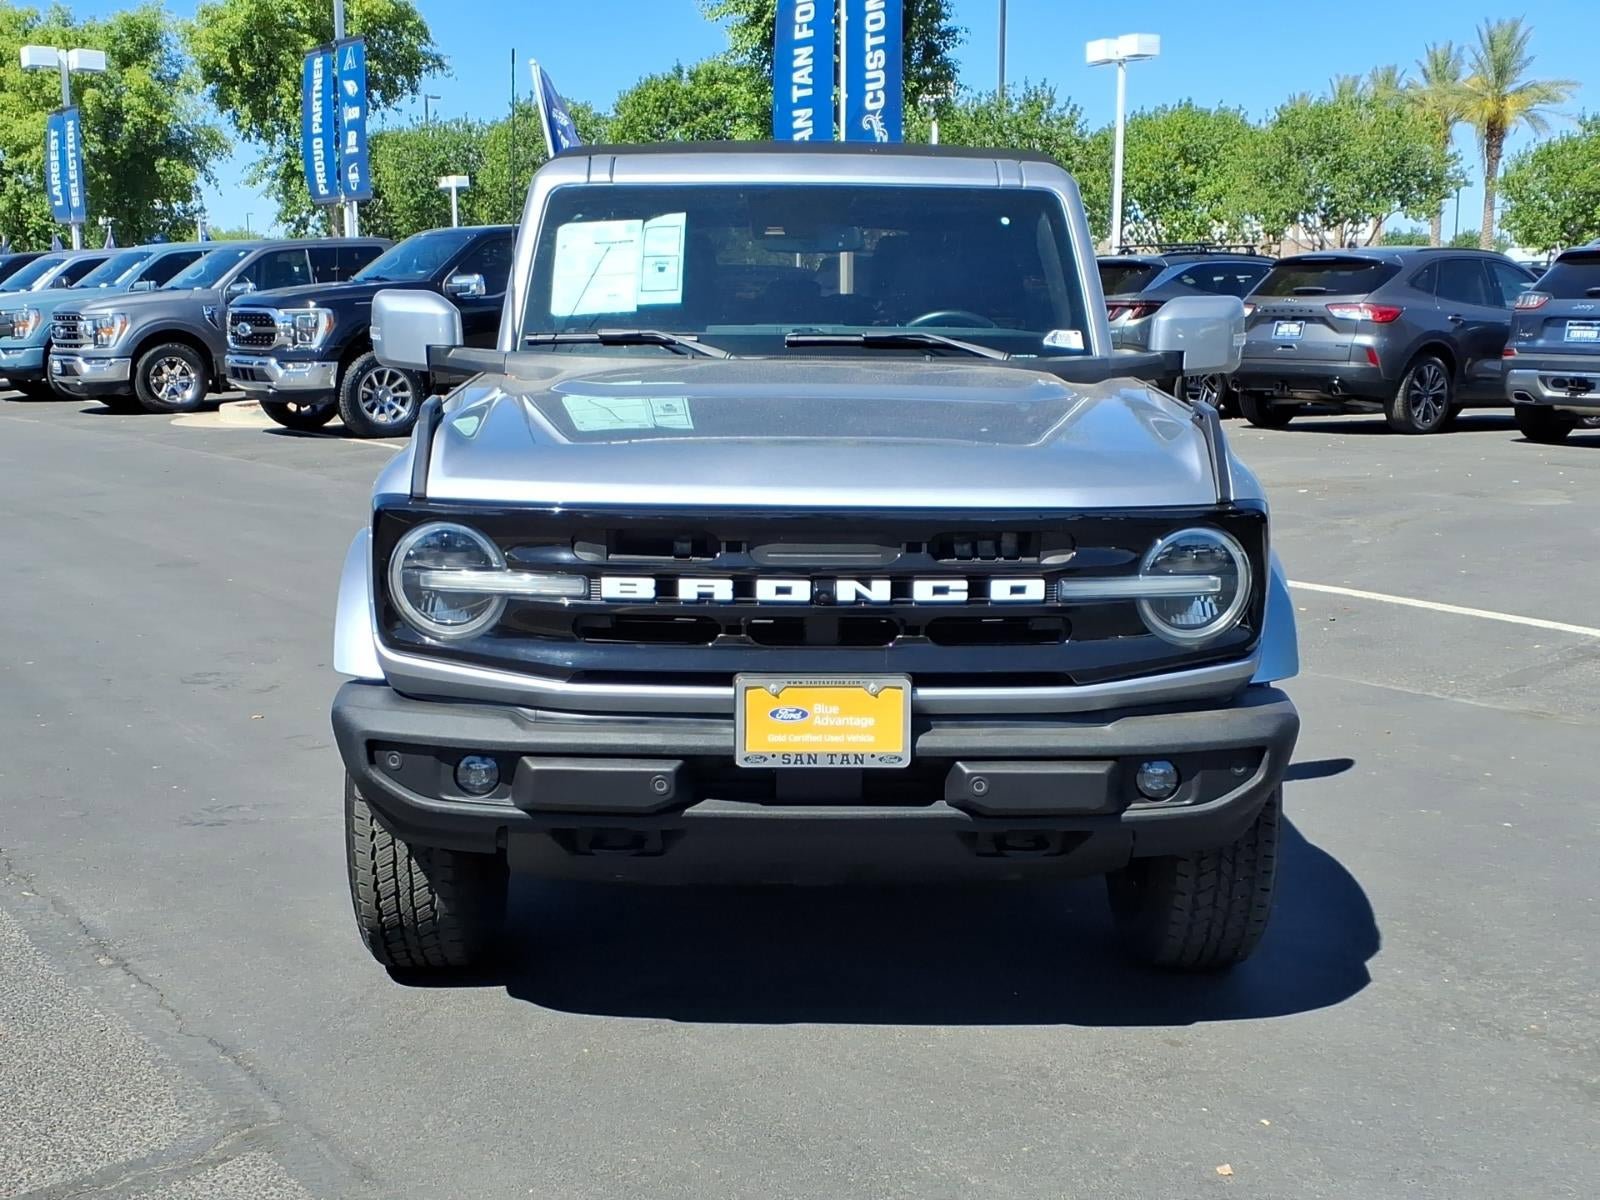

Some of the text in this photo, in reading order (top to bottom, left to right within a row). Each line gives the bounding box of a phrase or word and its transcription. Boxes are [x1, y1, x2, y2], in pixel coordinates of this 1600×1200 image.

[792, 0, 815, 141] AN TAN FO
[311, 56, 329, 195] PROUD PARTNER
[50, 128, 63, 206] LARGEST
[66, 120, 80, 208] SELECTION
[601, 576, 1045, 604] BRONCO
[775, 708, 803, 721] Ford
[813, 703, 840, 714] Blue
[813, 714, 875, 727] Advantage
[782, 753, 865, 765] SAN TAN
